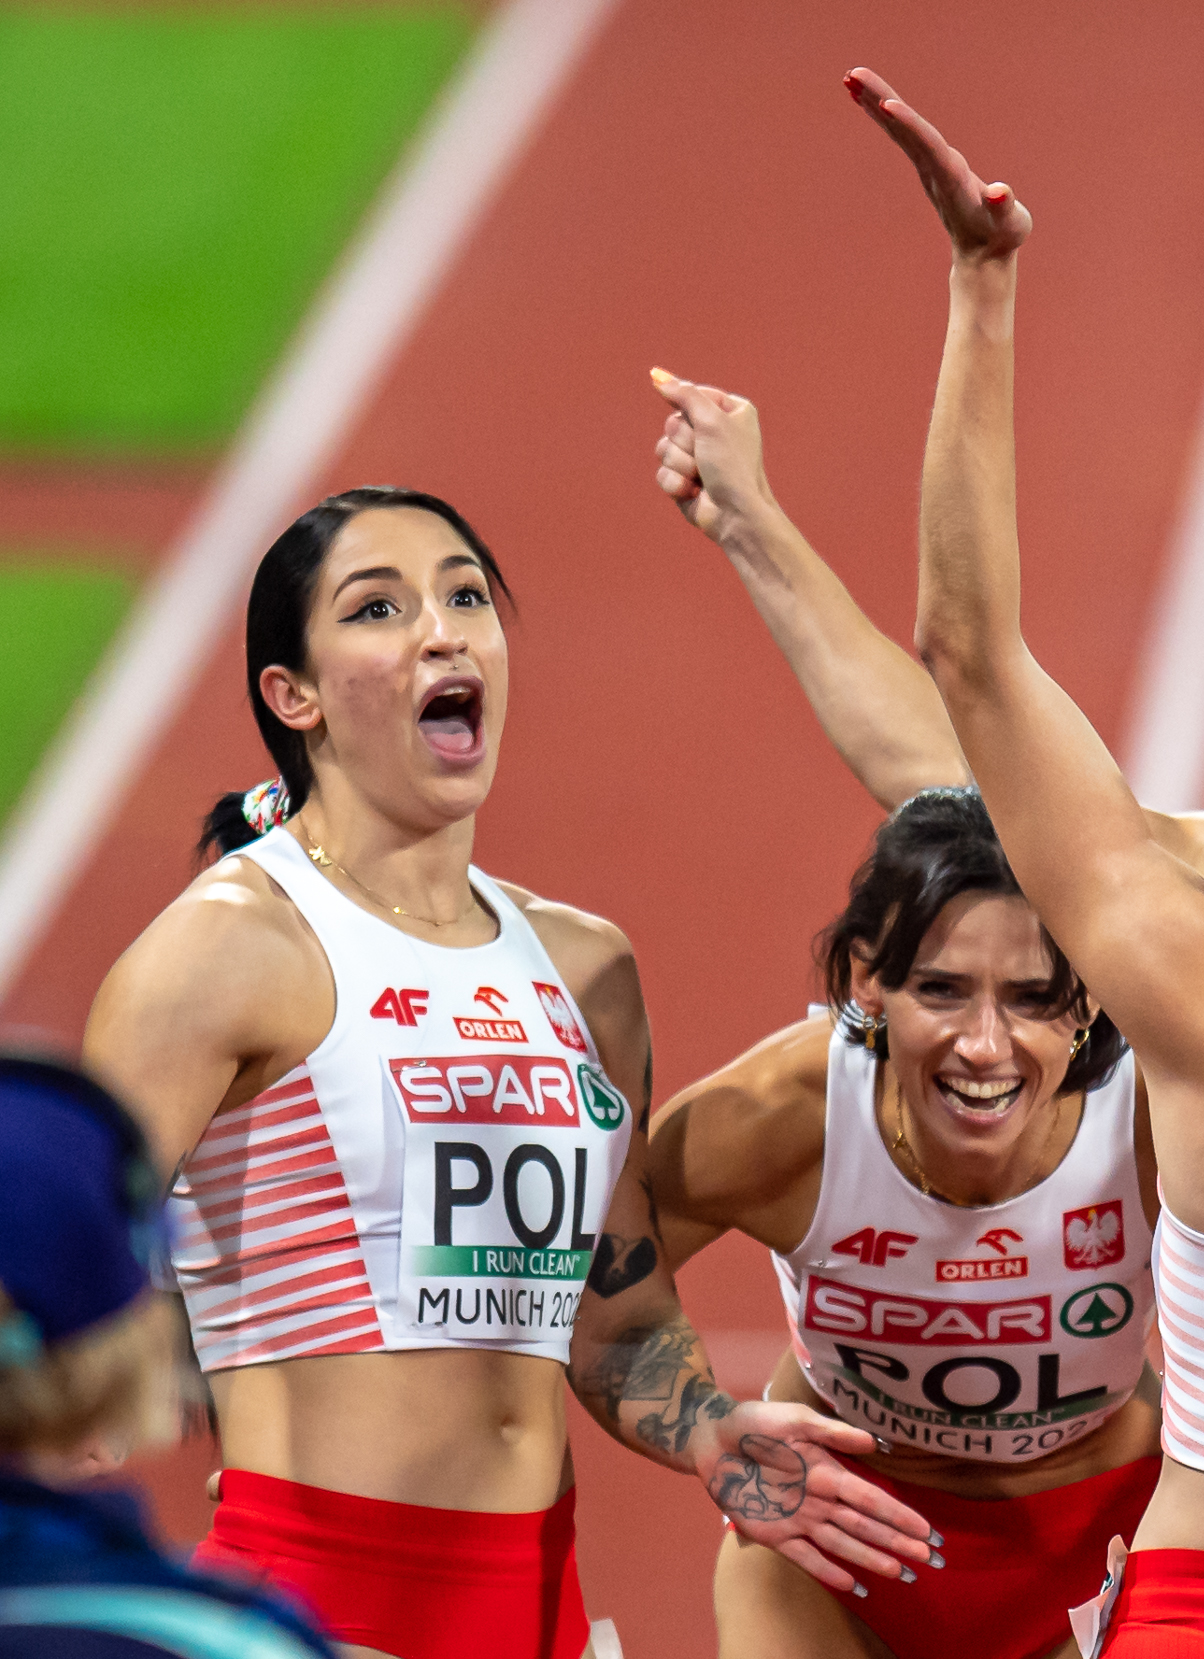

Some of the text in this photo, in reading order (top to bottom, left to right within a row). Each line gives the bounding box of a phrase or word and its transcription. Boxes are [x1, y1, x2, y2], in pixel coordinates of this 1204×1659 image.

[369, 987, 430, 1027] 4F
[460, 1020, 523, 1041] ORLEN
[400, 1064, 576, 1117] SPAR
[434, 1141, 597, 1250] POL
[472, 1250, 479, 1274] I
[486, 1250, 525, 1274] RUN
[831, 1227, 920, 1268] 4F
[941, 1260, 1023, 1280] ORLEN
[417, 1287, 581, 1328] MUNICH 202
[812, 1286, 1046, 1341] SPAR
[834, 1342, 1108, 1416] POL
[833, 1376, 1088, 1456] MUNICH 202
